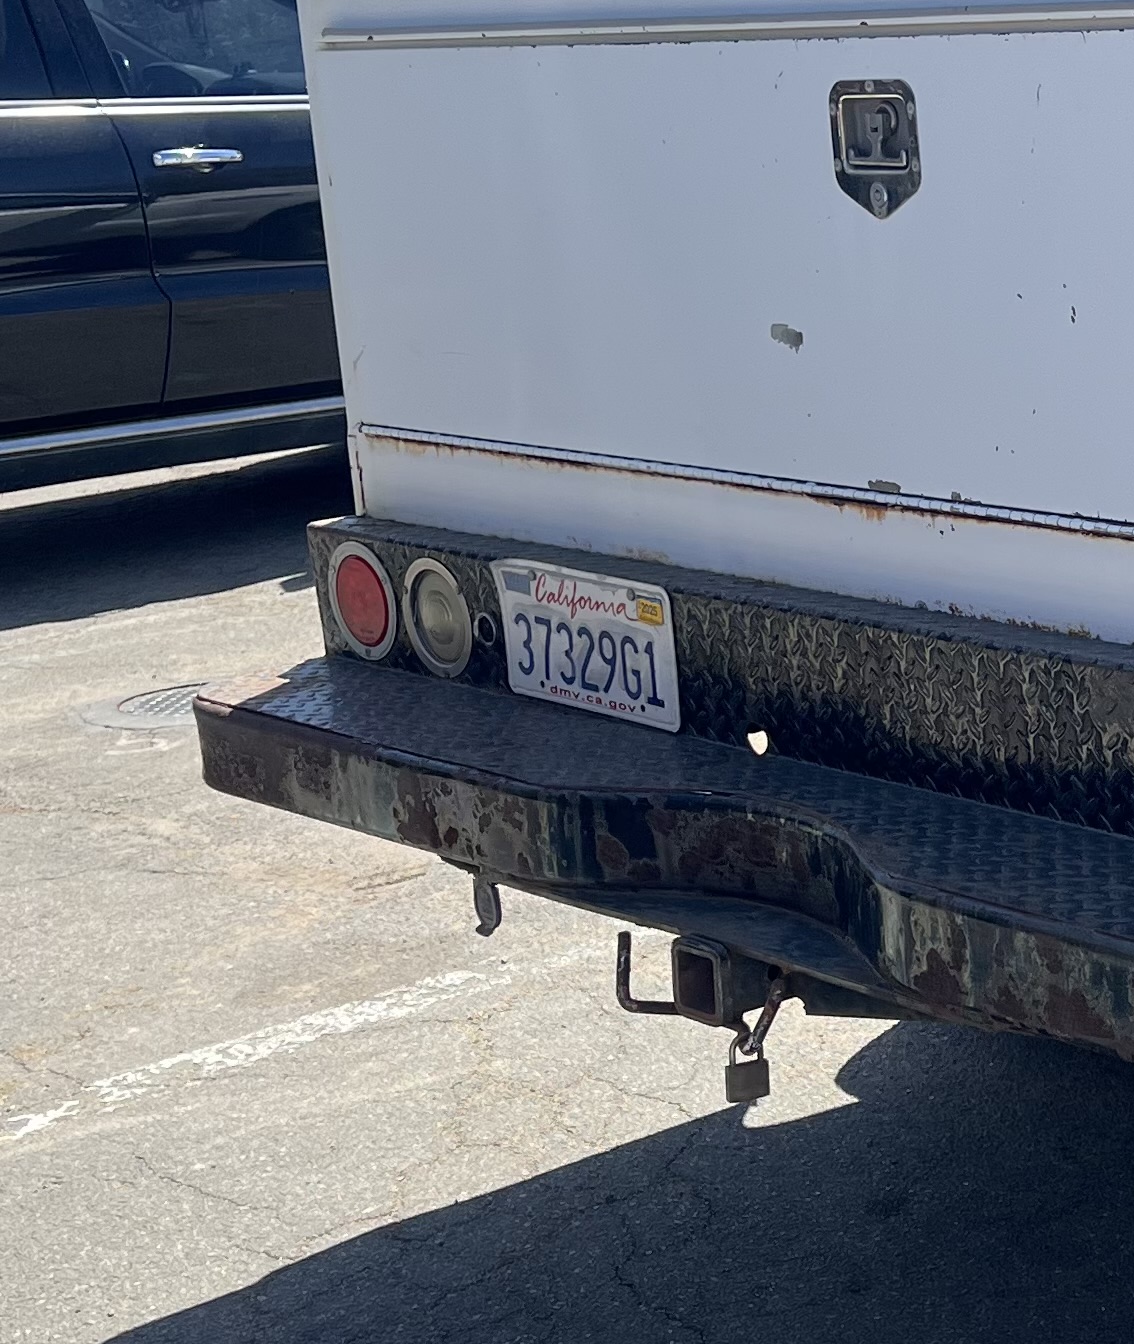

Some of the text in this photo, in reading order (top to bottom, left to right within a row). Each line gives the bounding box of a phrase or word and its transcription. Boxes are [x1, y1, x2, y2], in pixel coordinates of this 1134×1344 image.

[535, 573, 638, 621] California
[514, 612, 665, 708] 37329G1
[550, 685, 637, 713] dmv.ca.gov
